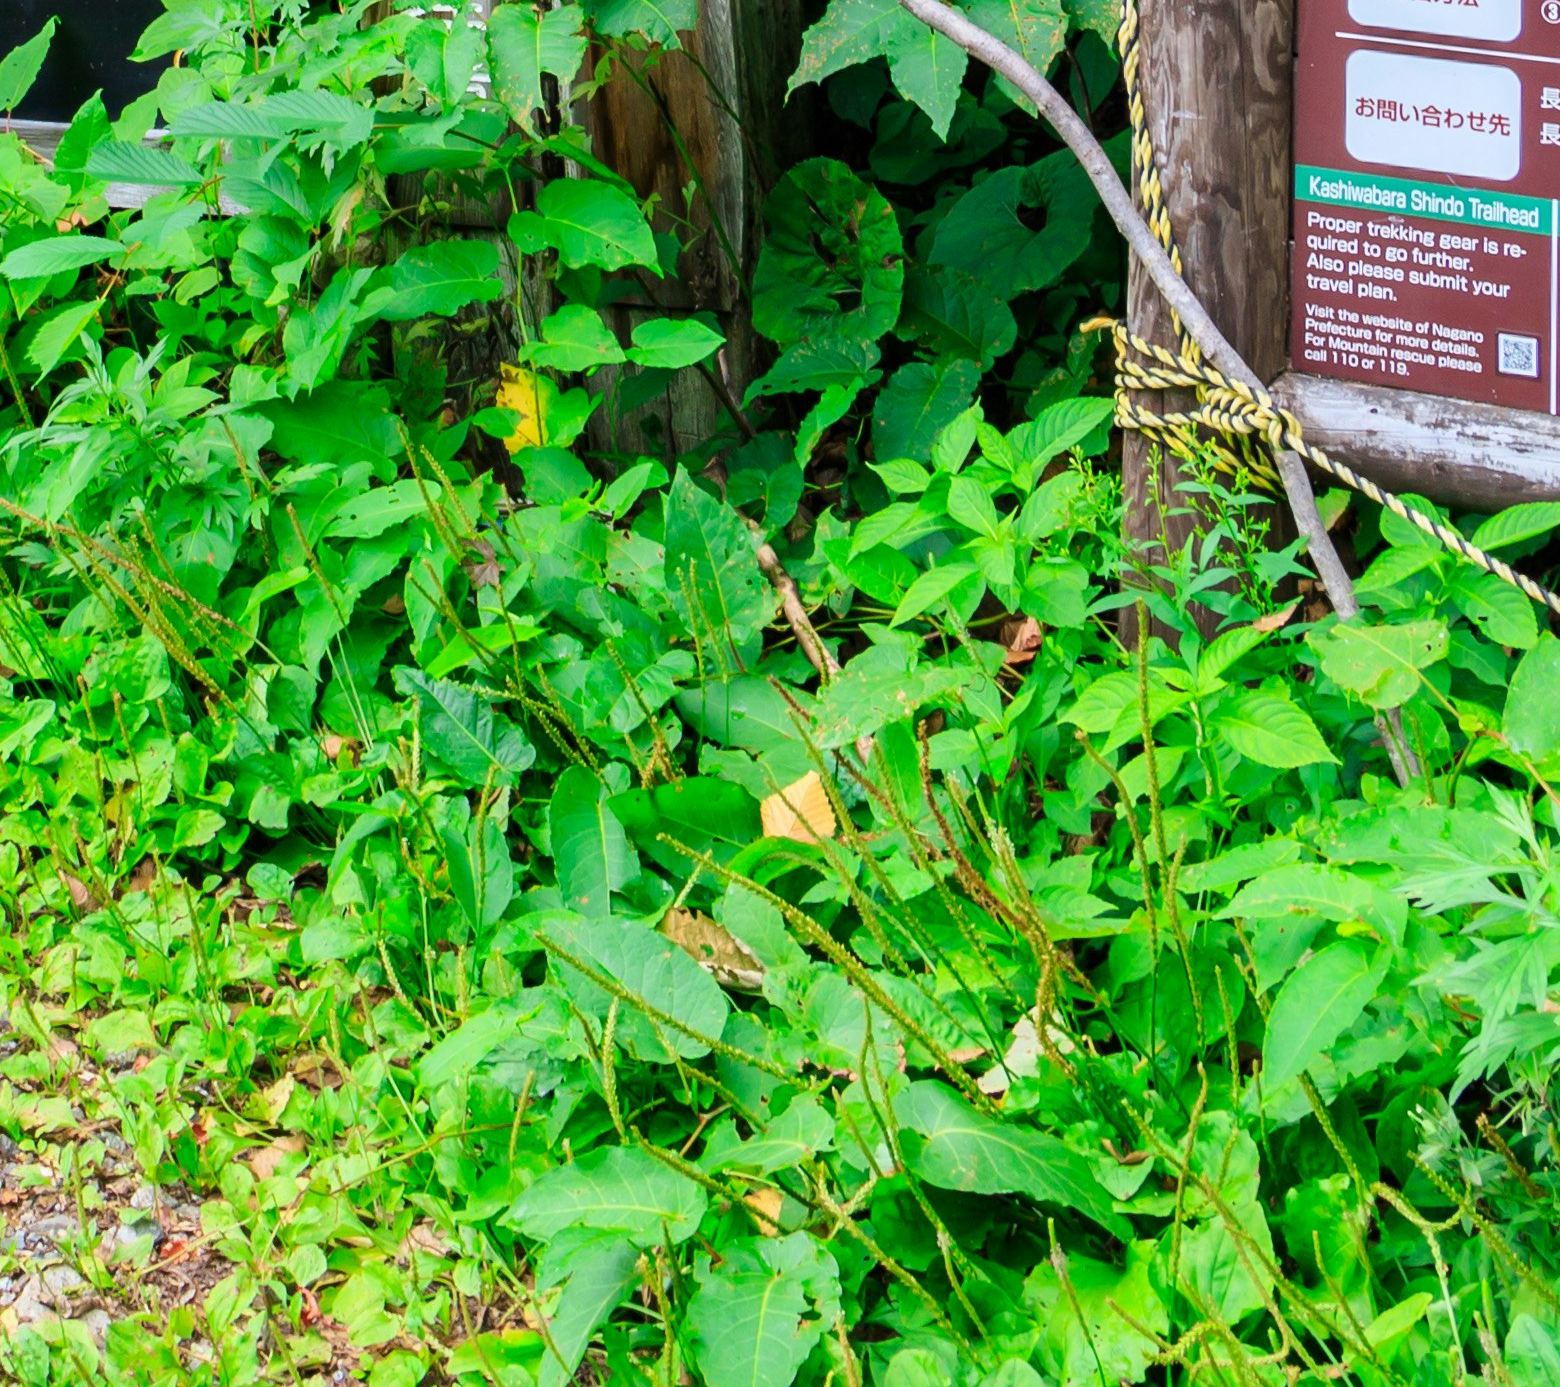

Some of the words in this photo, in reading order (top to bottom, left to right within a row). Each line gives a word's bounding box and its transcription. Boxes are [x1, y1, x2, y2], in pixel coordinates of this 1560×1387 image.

[1356, 96, 1511, 136] お問い合わせ先
[1309, 175, 1406, 210] Kashiwabara
[1411, 190, 1464, 217] Shindo
[1469, 198, 1539, 228] Trailhead
[1307, 211, 1362, 234] Proper
[1367, 222, 1435, 247] trekking
[1440, 232, 1479, 249] gear
[1483, 237, 1499, 253] is
[1503, 243, 1527, 259] re-
[1307, 235, 1358, 255] quired
[1363, 242, 1381, 258] to
[1385, 246, 1407, 262] go
[1412, 248, 1474, 272] further.
[1306, 274, 1353, 294] travel
[1358, 281, 1397, 301] plan.
[1307, 253, 1344, 272] Also
[1348, 259, 1404, 282] please
[1409, 269, 1468, 292] submit
[1473, 280, 1510, 298] your
[1305, 303, 1335, 318] Visit
[1338, 308, 1359, 323] the
[1362, 312, 1412, 331] website
[1416, 322, 1429, 334] of
[1432, 323, 1483, 343] Nagano
[1305, 319, 1371, 340] Prefecture
[1375, 329, 1392, 343] for
[1396, 333, 1429, 349] more
[1432, 338, 1480, 358] details.
[1305, 333, 1326, 347] For
[1329, 336, 1387, 357] Mountain
[1390, 349, 1435, 365] rescue
[1439, 353, 1482, 373] please
[1305, 350, 1327, 363] call
[1331, 351, 1358, 368] 110
[1362, 357, 1375, 370] or
[1380, 360, 1410, 376] 119.
